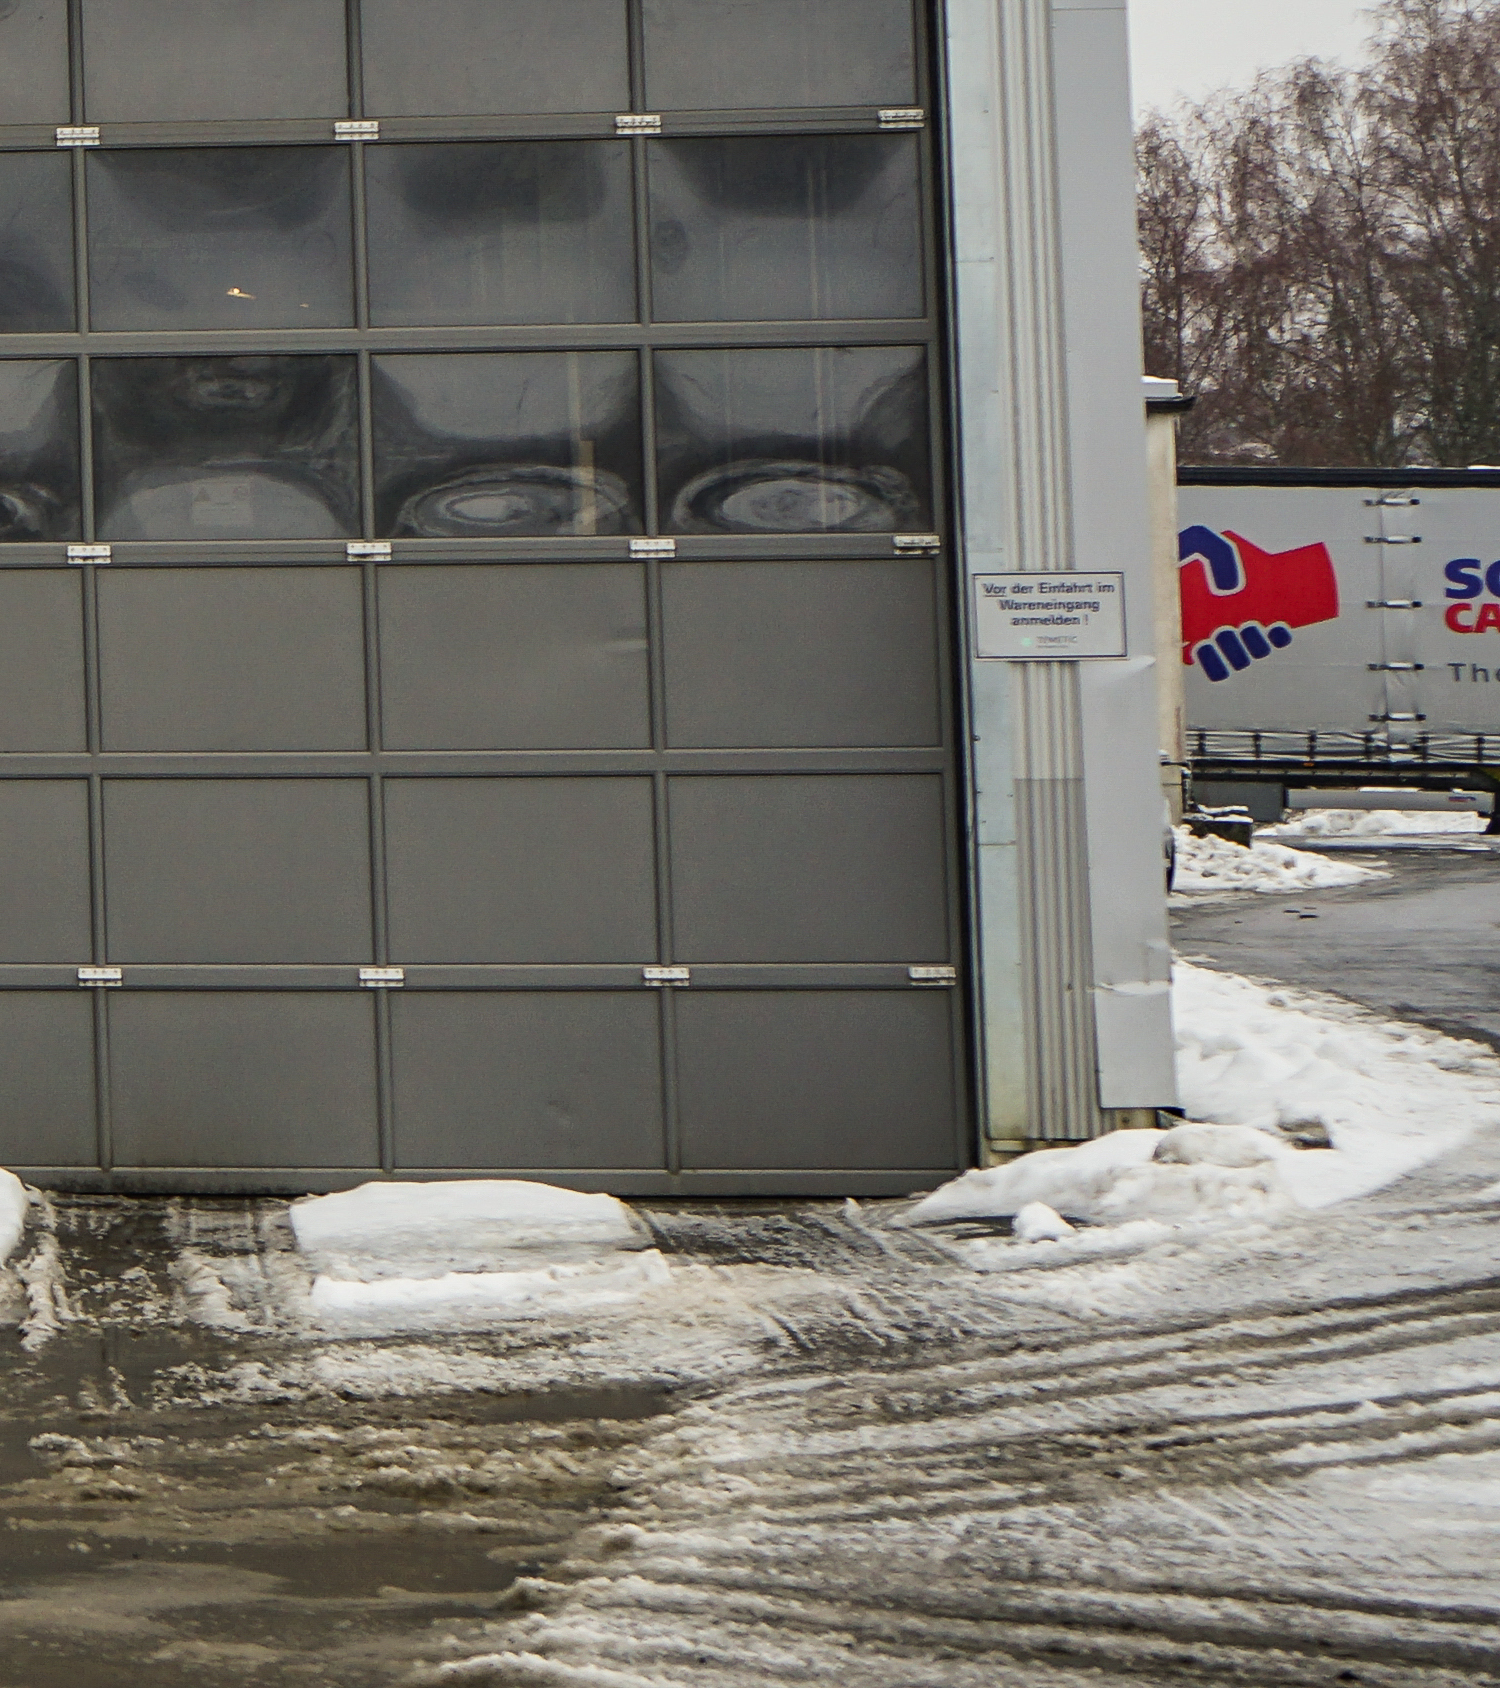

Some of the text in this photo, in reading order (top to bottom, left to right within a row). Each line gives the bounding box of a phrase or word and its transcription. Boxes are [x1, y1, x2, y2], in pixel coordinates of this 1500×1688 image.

[983, 582, 1115, 595] Vor der Einfahrt im
[999, 599, 1100, 612] Wareneingang
[1011, 614, 1081, 626] anmelden
